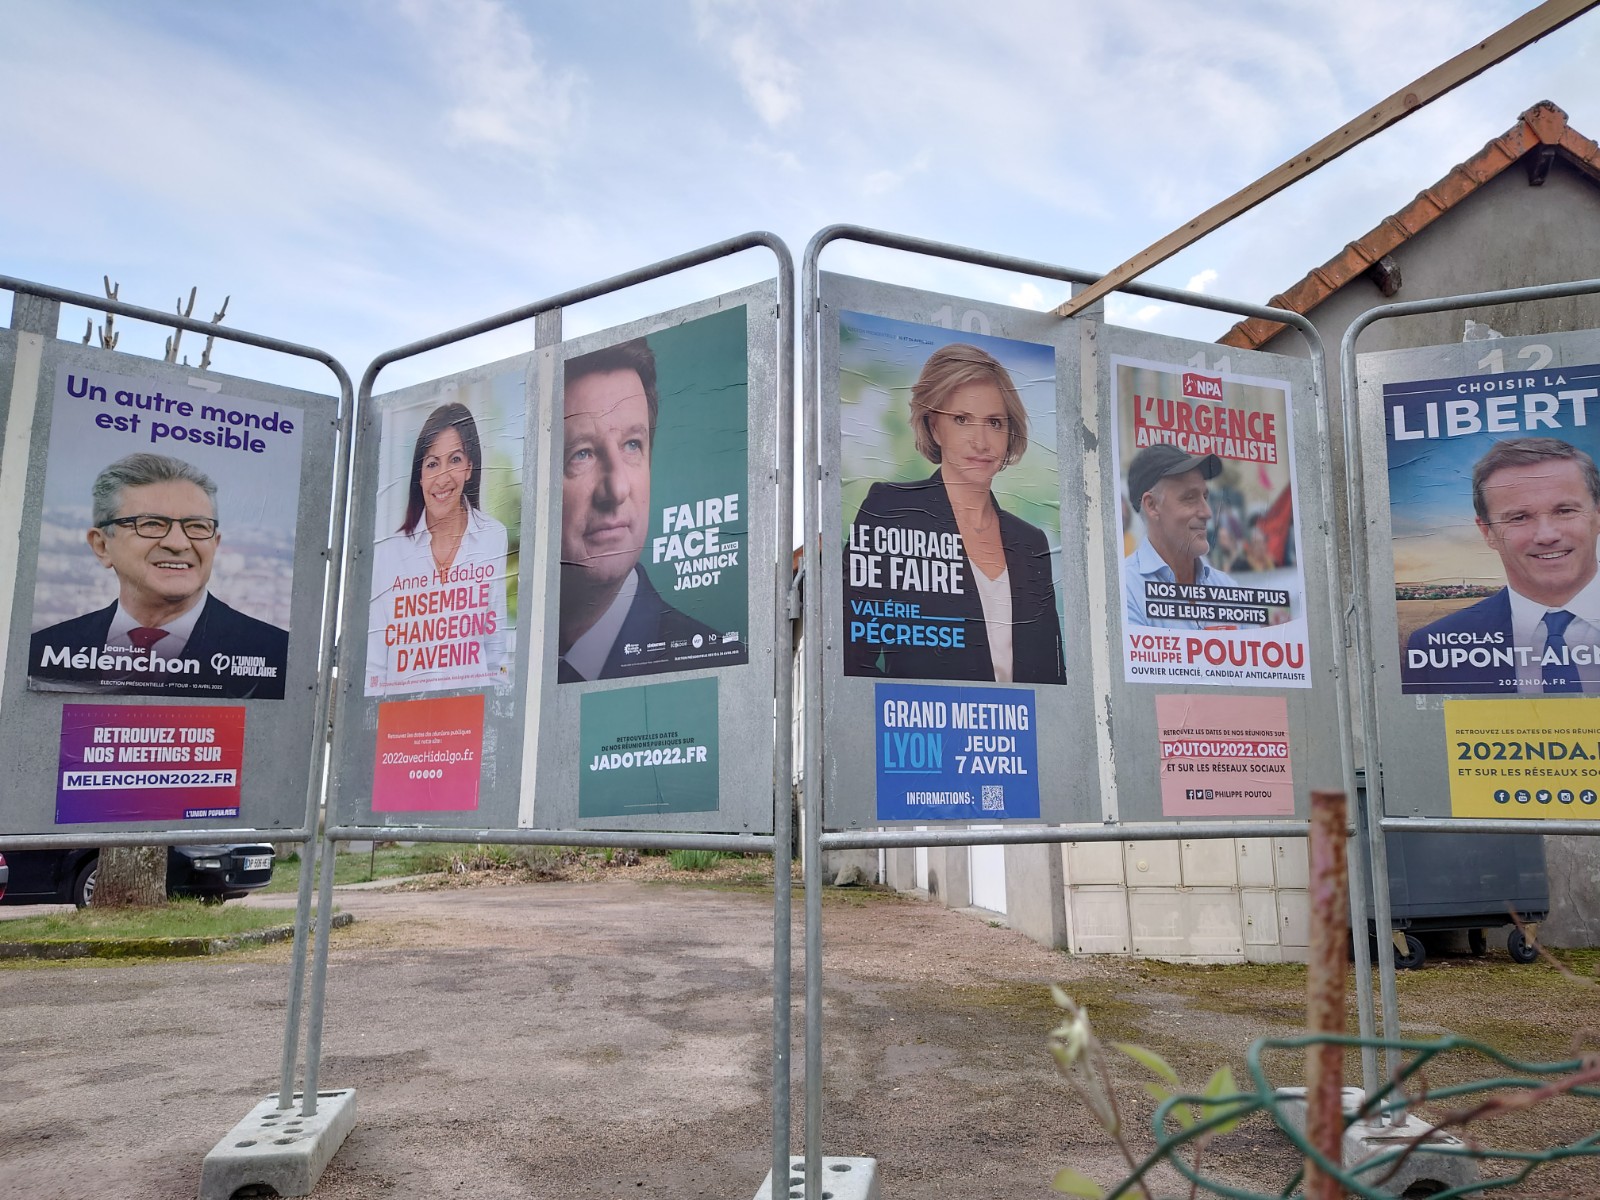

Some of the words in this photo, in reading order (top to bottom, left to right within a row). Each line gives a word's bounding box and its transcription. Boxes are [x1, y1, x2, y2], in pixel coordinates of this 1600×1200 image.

[1197, 380, 1222, 397] NPA
[1457, 378, 1535, 394] CHOISIR
[1544, 375, 1566, 386] LA
[67, 375, 107, 402] Un
[114, 390, 194, 416] autre
[201, 405, 294, 434] monde
[1134, 395, 1275, 440] L'URGENCE
[95, 412, 140, 433] est
[150, 421, 266, 453] possible
[1137, 427, 1275, 462] ANTICAPITALISTE
[663, 494, 739, 533] FAIRE
[652, 527, 719, 564] FACE
[850, 523, 870, 552] LE
[874, 526, 964, 561] COURAGE
[674, 552, 738, 575] YANNICK
[392, 575, 428, 592] Anne
[432, 563, 494, 585] Hidalgo
[674, 571, 721, 591] JADOT
[850, 554, 882, 589] DE
[890, 557, 964, 595] FAIRE
[394, 584, 490, 619] ENSEMBLE
[1148, 583, 1176, 598] NOS
[1180, 585, 1206, 600] VIES
[1209, 588, 1254, 602] VALENT
[1258, 592, 1286, 604] PLUS
[851, 599, 920, 619] VALÉRIE
[1148, 603, 1175, 618] QUE
[1179, 606, 1216, 620] LEURS
[1218, 609, 1266, 622] PROFITS
[385, 610, 496, 647] CHANGEONS
[851, 617, 965, 649] PÉCRESSE
[1130, 634, 1181, 651] VOTEZ
[1428, 632, 1504, 645] NICOLAS
[102, 644, 146, 653] Jean-Luc
[397, 641, 480, 673] D'AVENIR
[1130, 650, 1182, 664] PHILIPPE
[1187, 637, 1304, 669] POUTOU
[40, 645, 200, 674] Mélenchon
[232, 655, 266, 667] L'UNION
[231, 666, 278, 678] POPULAIRE
[1132, 666, 1166, 676] OUVRIER
[1206, 670, 1243, 679] CANDIDAT
[1246, 671, 1305, 680] ANTICAPITALISTE
[1498, 678, 1566, 686] 2022NDA.FR
[884, 700, 946, 729] GRAND
[952, 702, 1029, 730] MEETING
[94, 728, 175, 744] RETROUVEZ
[180, 728, 215, 743] TOUS
[617, 734, 648, 743] RETROUVEZ
[622, 740, 650, 749] RÉUNIONS
[651, 739, 681, 747] PUBLIQUES
[964, 736, 1016, 752] JEUDI
[84, 747, 114, 763] NOS
[118, 747, 190, 762] MEETINGS
[194, 747, 221, 762] SUR
[590, 746, 707, 771] JADOT2022.FR
[884, 732, 942, 768] LYON
[1164, 742, 1287, 757] POUTOU2022.ORG
[1456, 742, 1600, 760] 2022NDA.
[955, 756, 967, 774] 7
[971, 756, 1027, 774] AVRIL
[1167, 764, 1175, 772] ET
[1178, 764, 1194, 772] SUR
[1197, 764, 1210, 772] LES
[1212, 762, 1248, 773] RÉSEAUX
[1250, 764, 1286, 773] SOCIAUX
[1458, 768, 1472, 776] ET
[1475, 768, 1497, 776] SUR
[1501, 768, 1521, 776] LES
[1525, 766, 1578, 777] RÉSEAUX
[67, 773, 232, 786] MELENCHON2022.FR
